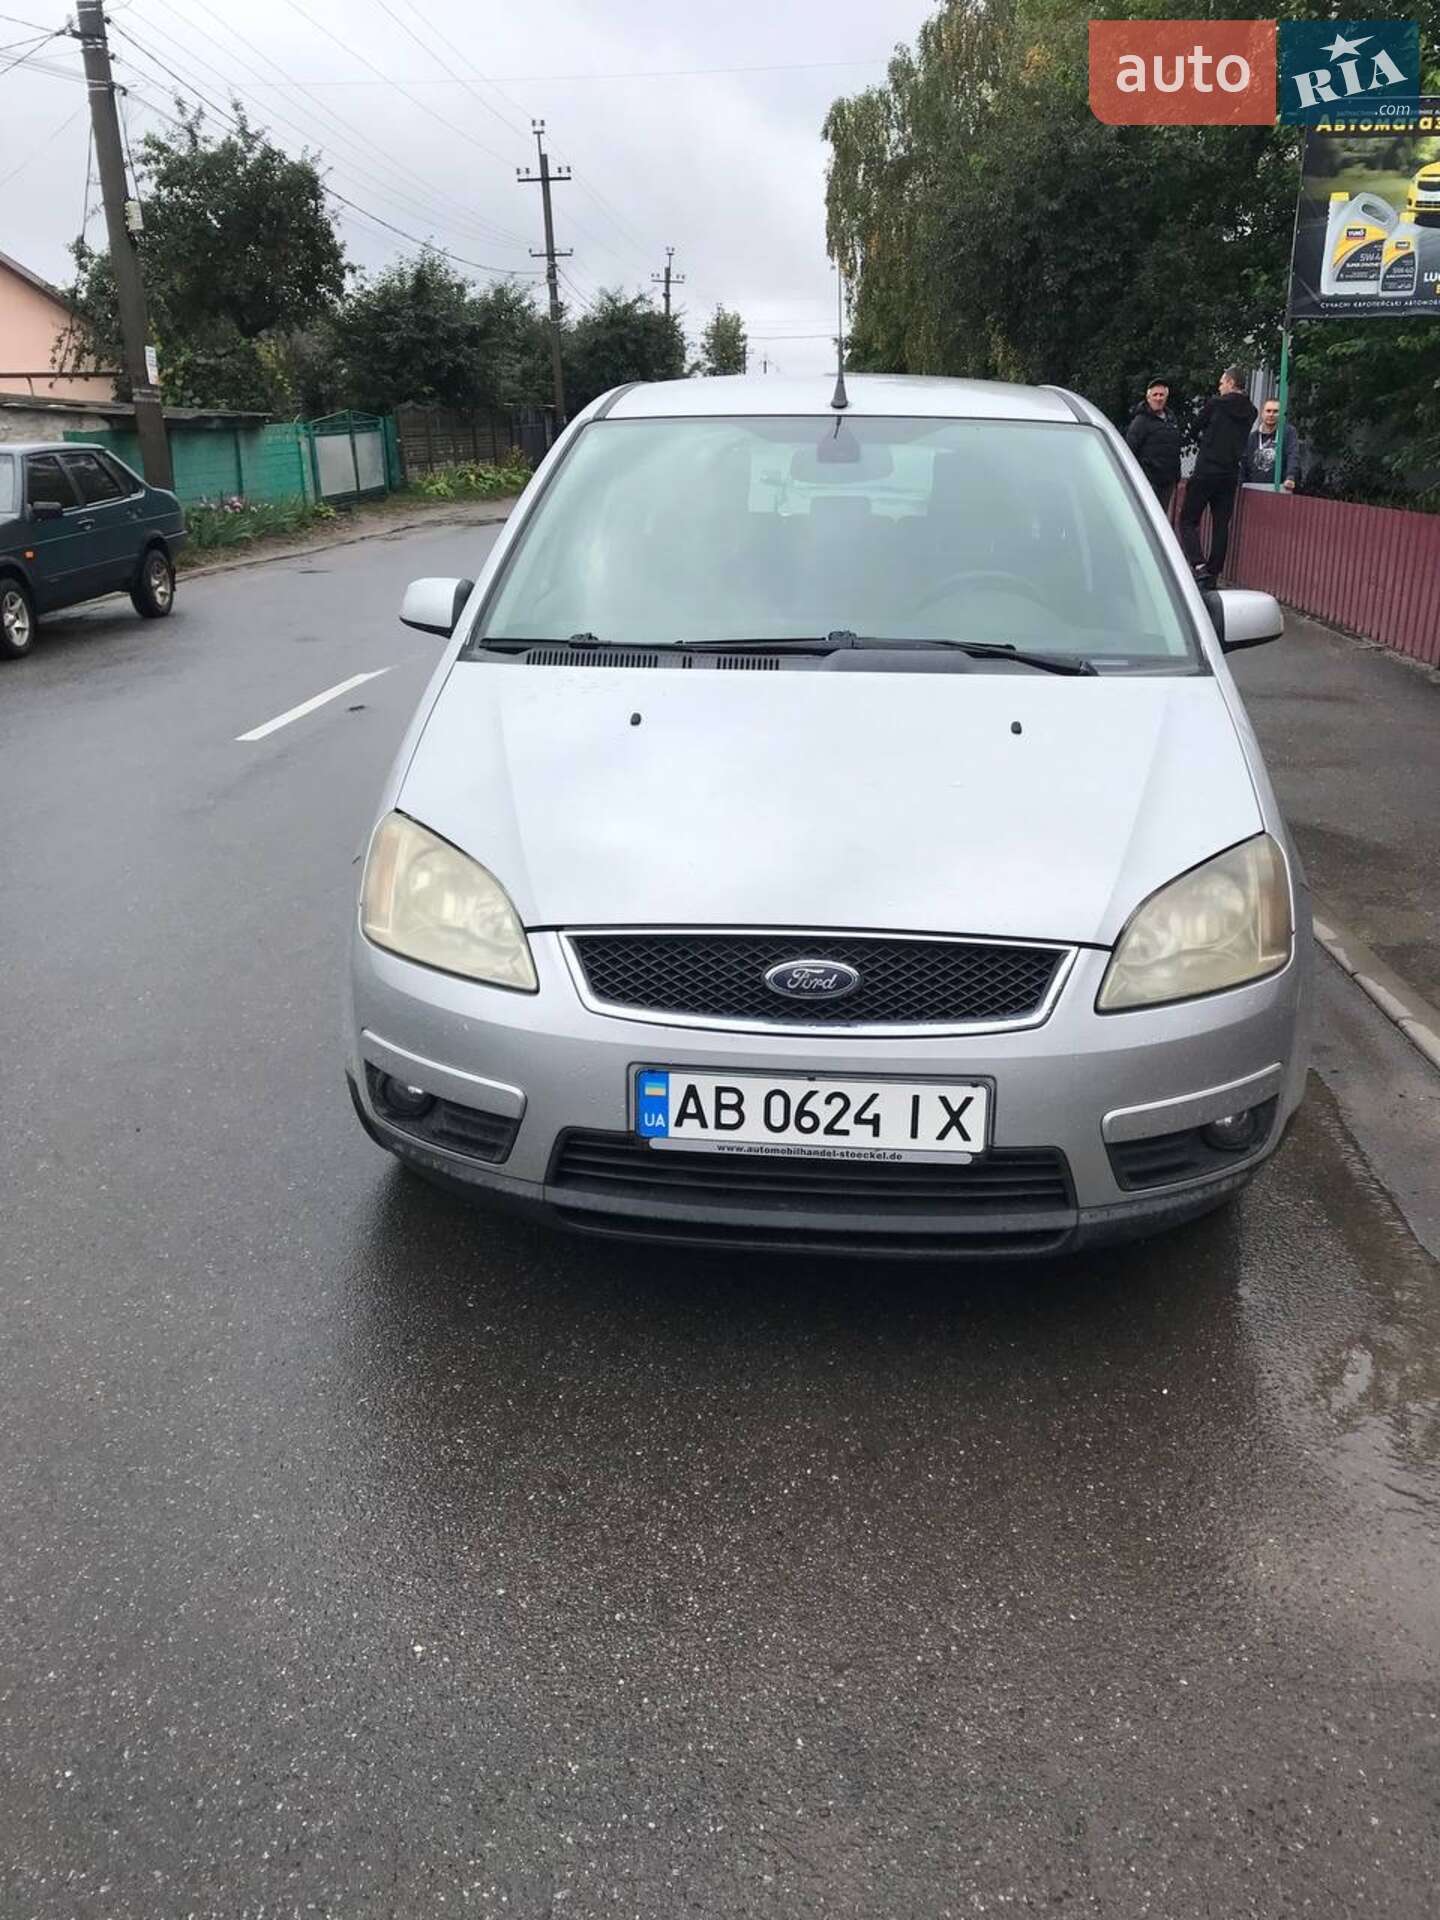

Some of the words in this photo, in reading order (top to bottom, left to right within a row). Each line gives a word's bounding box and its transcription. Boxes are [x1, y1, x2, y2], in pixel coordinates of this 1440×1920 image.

[786, 968, 838, 990] Ford
[644, 1112, 666, 1128] UA
[673, 1083, 746, 1131] AB
[762, 1088, 881, 1139] 0624
[909, 1094, 975, 1142] IX
[716, 1143, 903, 1161] www.automobilhandel-stoeckel.de
